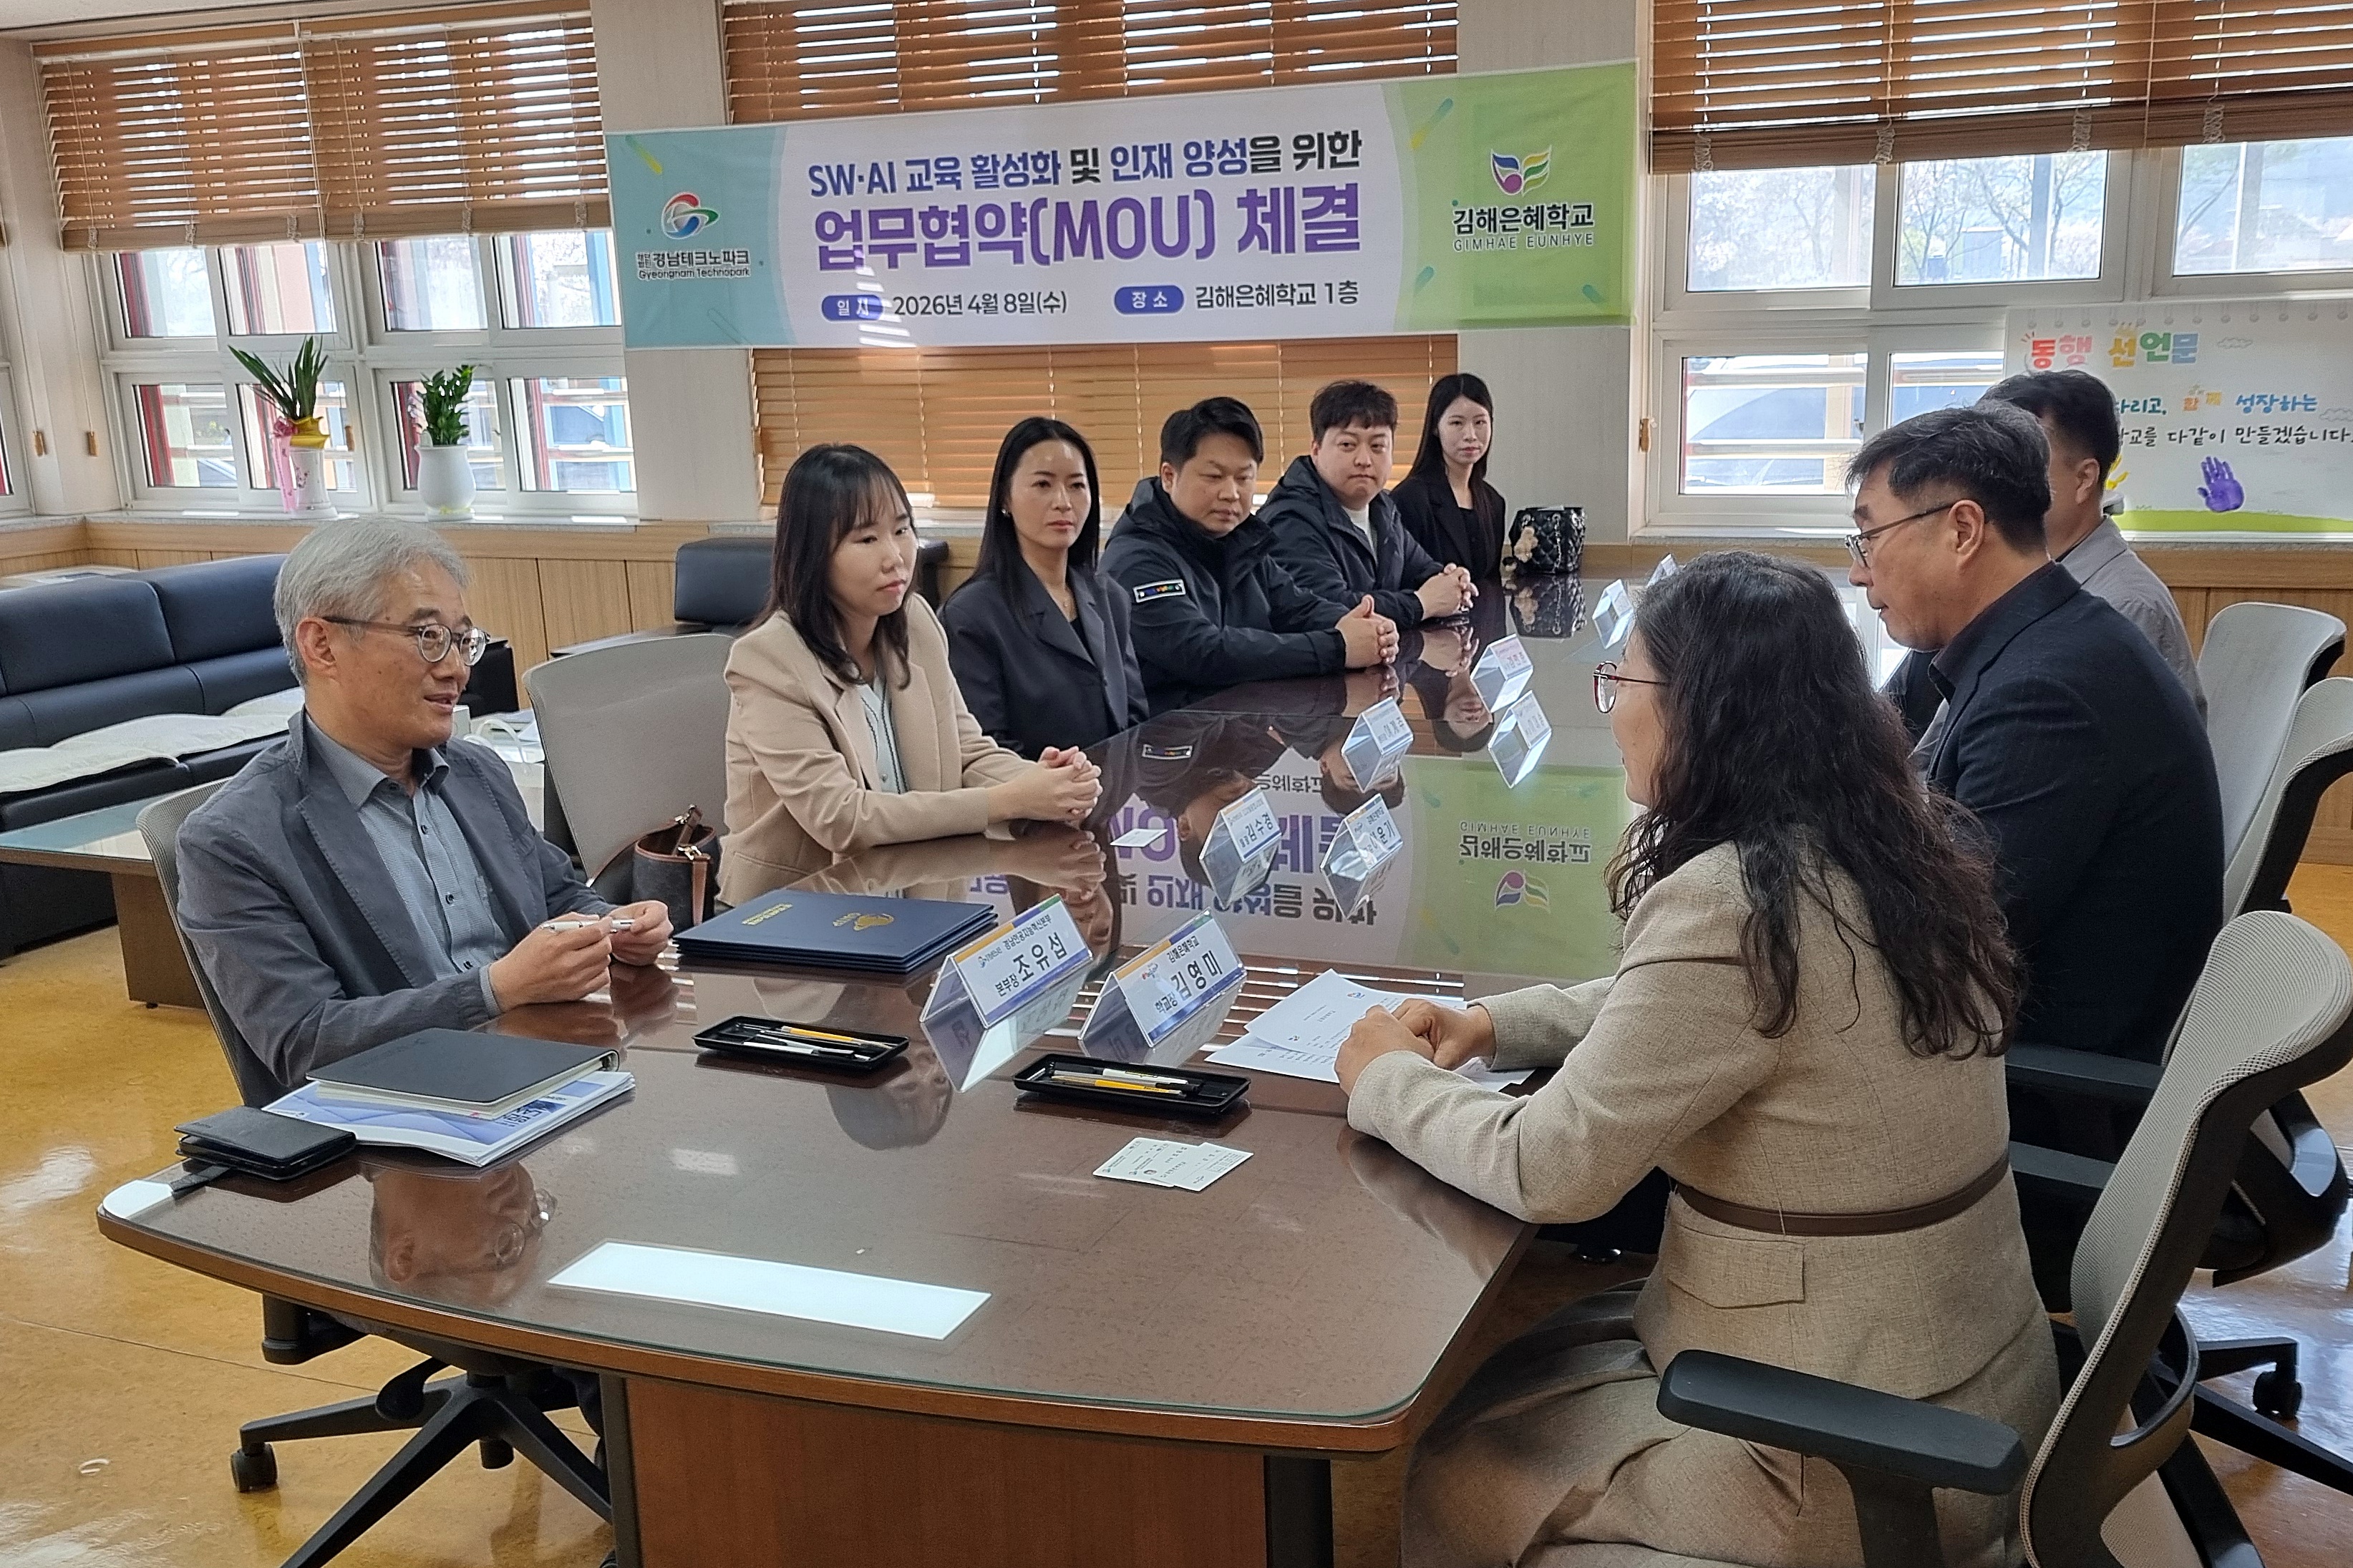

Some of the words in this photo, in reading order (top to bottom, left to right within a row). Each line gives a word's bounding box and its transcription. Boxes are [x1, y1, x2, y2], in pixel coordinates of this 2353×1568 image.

[808, 161, 897, 198] SW·AI
[906, 155, 962, 192] 교육
[971, 150, 1062, 190] 활성화
[1069, 147, 1101, 184] 및
[1110, 142, 1173, 182] 인재
[1183, 135, 1281, 177] 양성을
[1292, 130, 1362, 172] 위한
[815, 189, 1216, 271] 업무협약(MOU)
[1237, 182, 1360, 254] 체결
[1452, 203, 1594, 235] 김해은혜학교
[1453, 237, 1517, 252] GIMHAE
[1527, 233, 1593, 248] EUNHYE
[652, 250, 749, 268] 경남테크노파크
[639, 269, 695, 279] Gyeongnam
[697, 268, 750, 278] Technopark
[893, 296, 963, 316] 2026년
[968, 293, 998, 315] 4월
[1004, 291, 1067, 314] 8일(수)
[1195, 283, 1316, 309] 김해은혜학교
[1324, 280, 1359, 305] 1층
[2031, 334, 2092, 369] 동행
[2107, 332, 2199, 368] 선언문
[2236, 394, 2318, 414] 성장하는
[2168, 427, 2226, 446] 다같이
[1245, 812, 1273, 842] 김수경
[1166, 935, 1200, 963] 김해은혜학교
[995, 973, 1020, 997] 본부장
[1155, 991, 1178, 1013] 학교장
